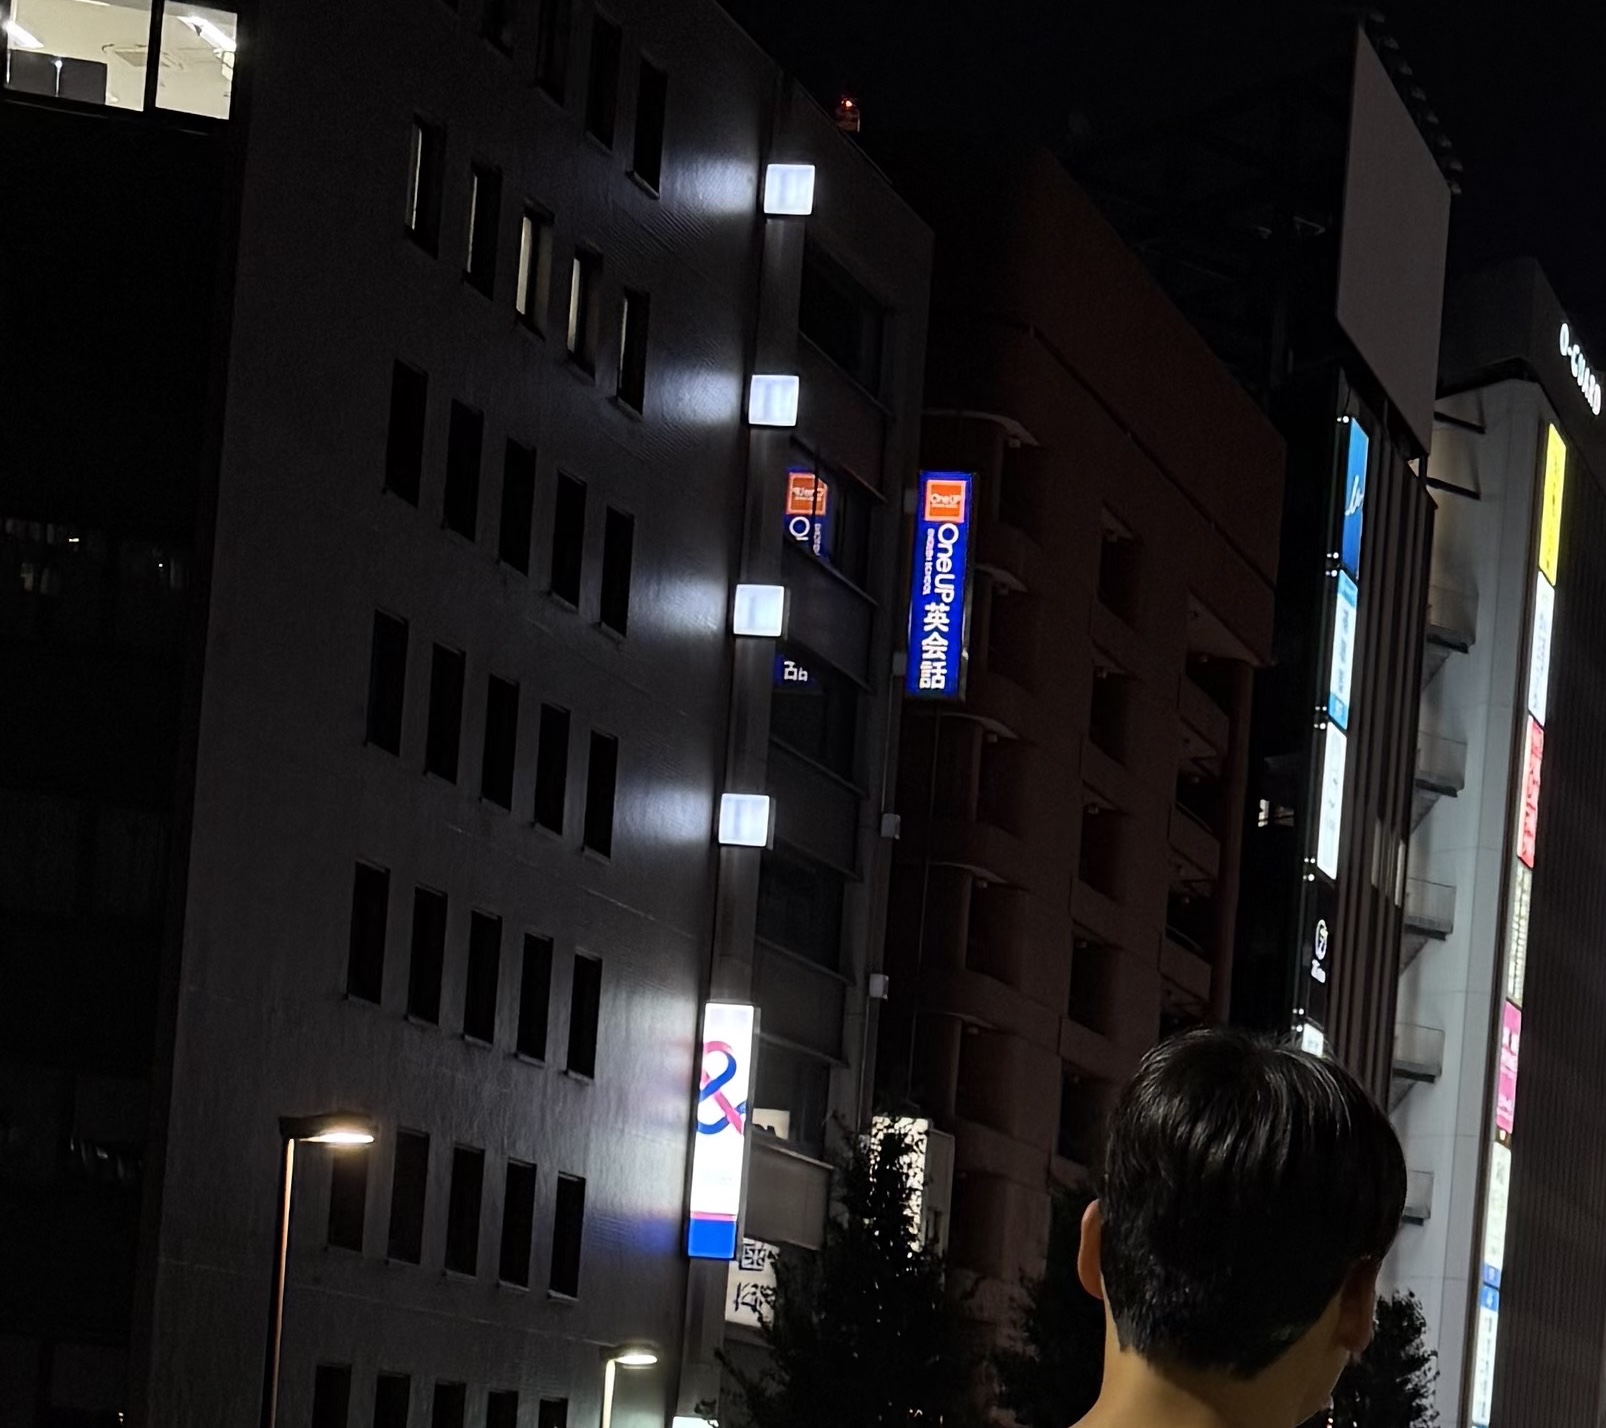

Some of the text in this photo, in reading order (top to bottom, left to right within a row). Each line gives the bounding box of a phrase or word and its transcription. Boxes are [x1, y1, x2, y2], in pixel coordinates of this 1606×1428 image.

[918, 522, 960, 690] OneUP 英会話
